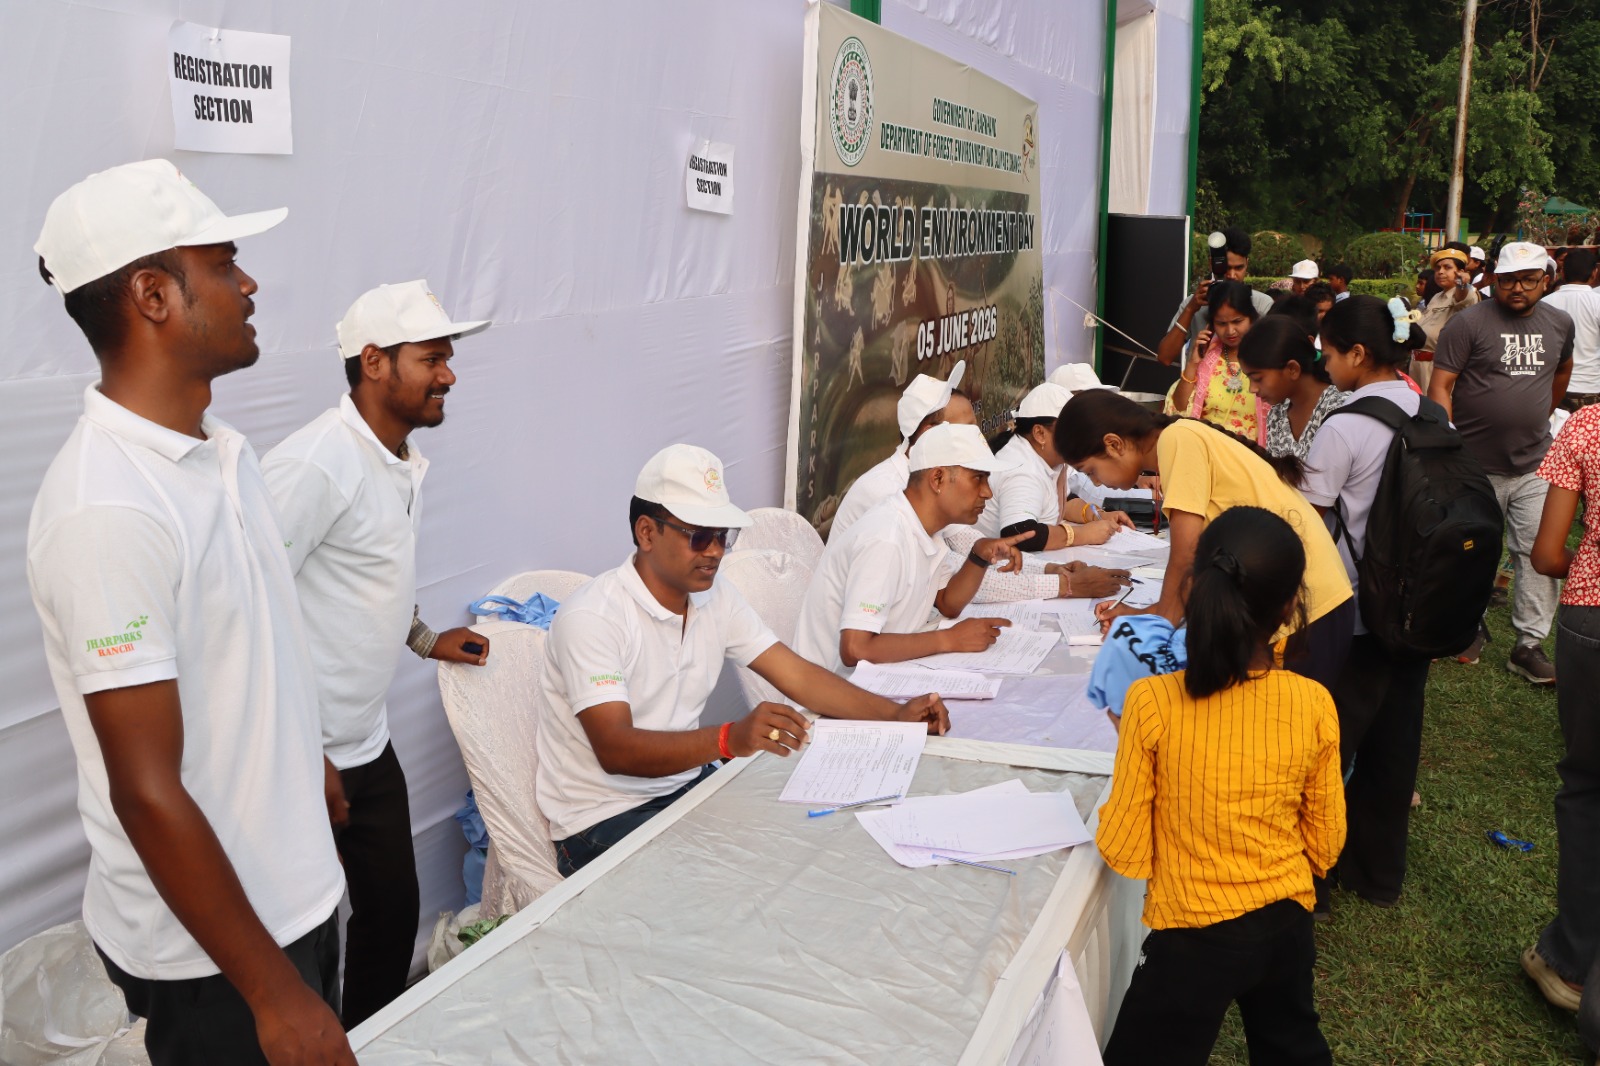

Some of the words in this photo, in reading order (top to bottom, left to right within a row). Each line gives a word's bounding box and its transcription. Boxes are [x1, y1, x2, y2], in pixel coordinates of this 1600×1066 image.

[173, 52, 272, 89] REGISTRATION
[193, 94, 253, 123] SECTION
[932, 97, 967, 128] GOVERNMENT
[967, 108, 975, 131] OF
[880, 122, 923, 155] DEPARTMENT
[923, 131, 932, 157] OF
[689, 154, 728, 177] REGISTRATION
[696, 177, 722, 197] SECTION
[840, 204, 916, 265] WORLD
[919, 206, 1017, 260] ENVIRONMENT
[1017, 211, 1035, 251] DAY
[917, 320, 935, 361] 05
[936, 312, 969, 356] JUNE
[970, 305, 997, 345] 2026
[1500, 334, 1545, 366] THE
[1500, 338, 1546, 363] Break
[807, 272, 825, 499] JHARPARKS
[86, 630, 143, 653] JHARPARKS
[97, 643, 135, 657] RANCHI
